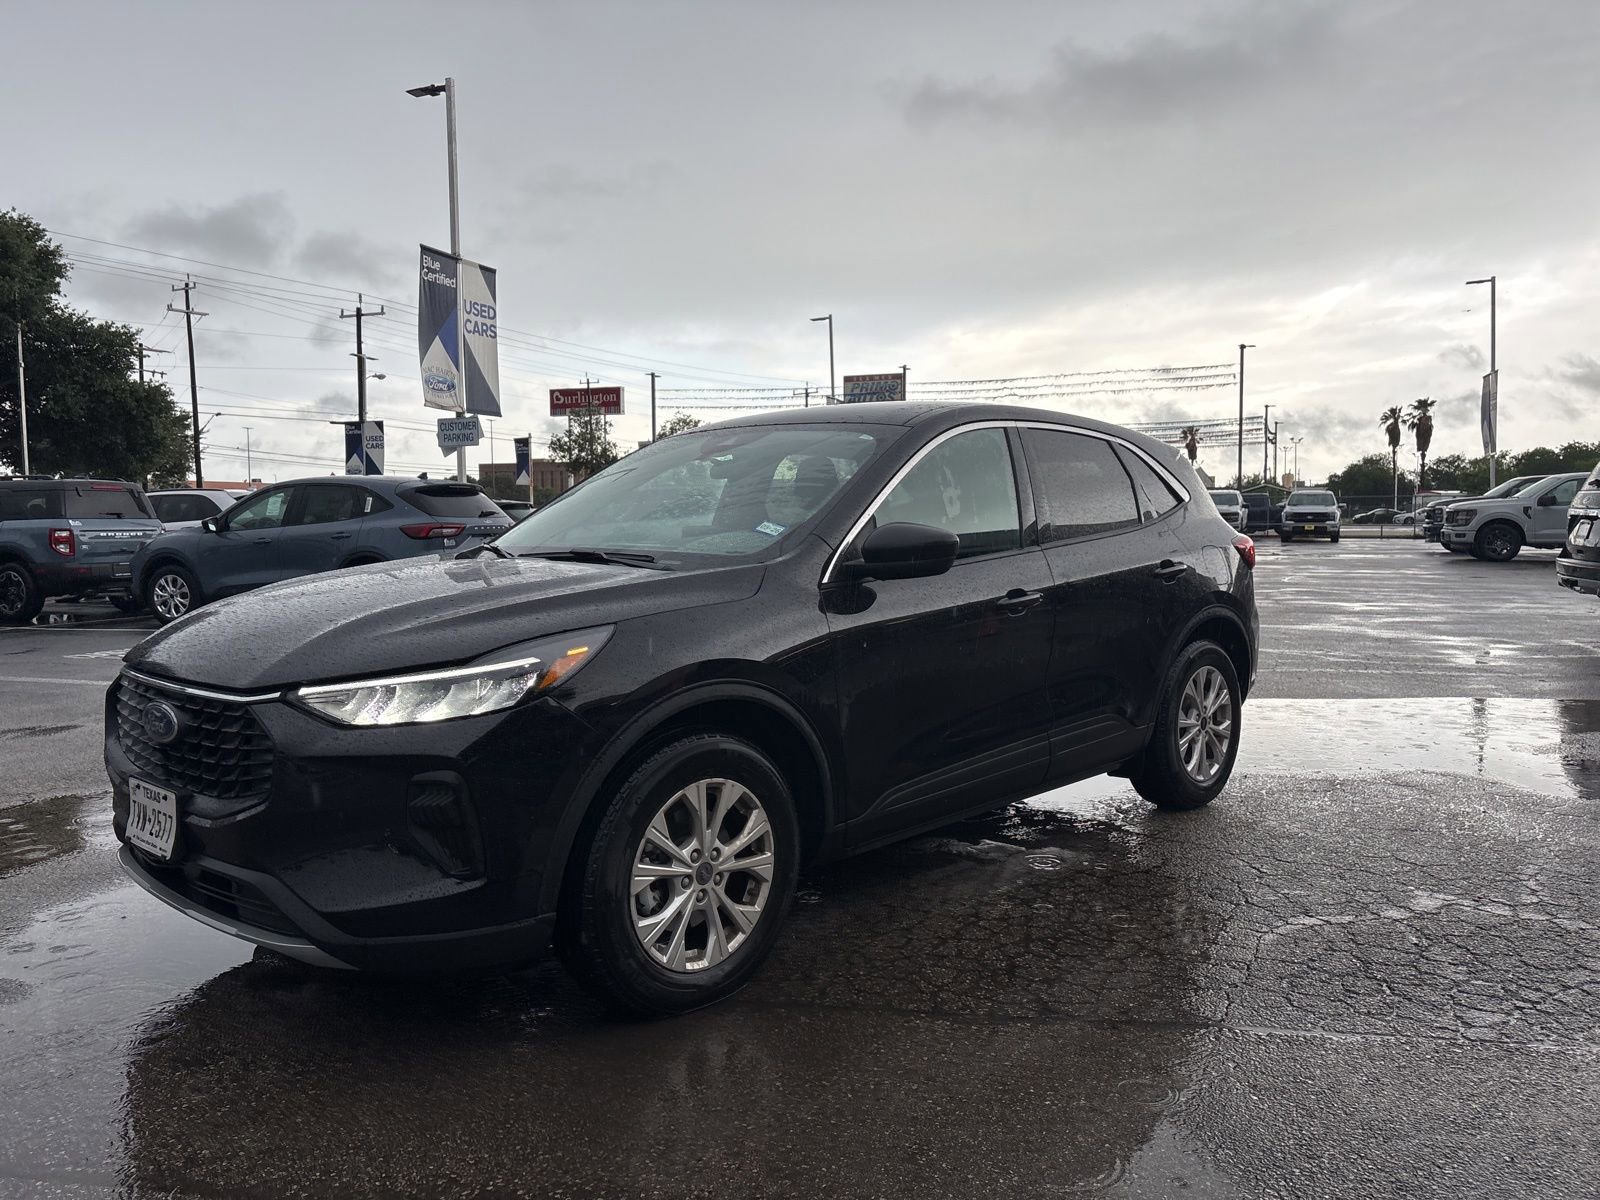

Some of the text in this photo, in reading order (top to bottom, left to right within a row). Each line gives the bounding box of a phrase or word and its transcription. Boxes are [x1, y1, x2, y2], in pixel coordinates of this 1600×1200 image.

[422, 255, 441, 271] Blue
[421, 268, 457, 288] Certified
[463, 299, 497, 321] USED
[464, 318, 498, 339] CARS
[428, 375, 450, 391] Ford
[552, 391, 617, 406] Burlington
[440, 421, 477, 432] CUSTOMER
[443, 432, 474, 442] PARKING
[365, 442, 385, 450] CARS
[142, 786, 161, 804] TEXAS
